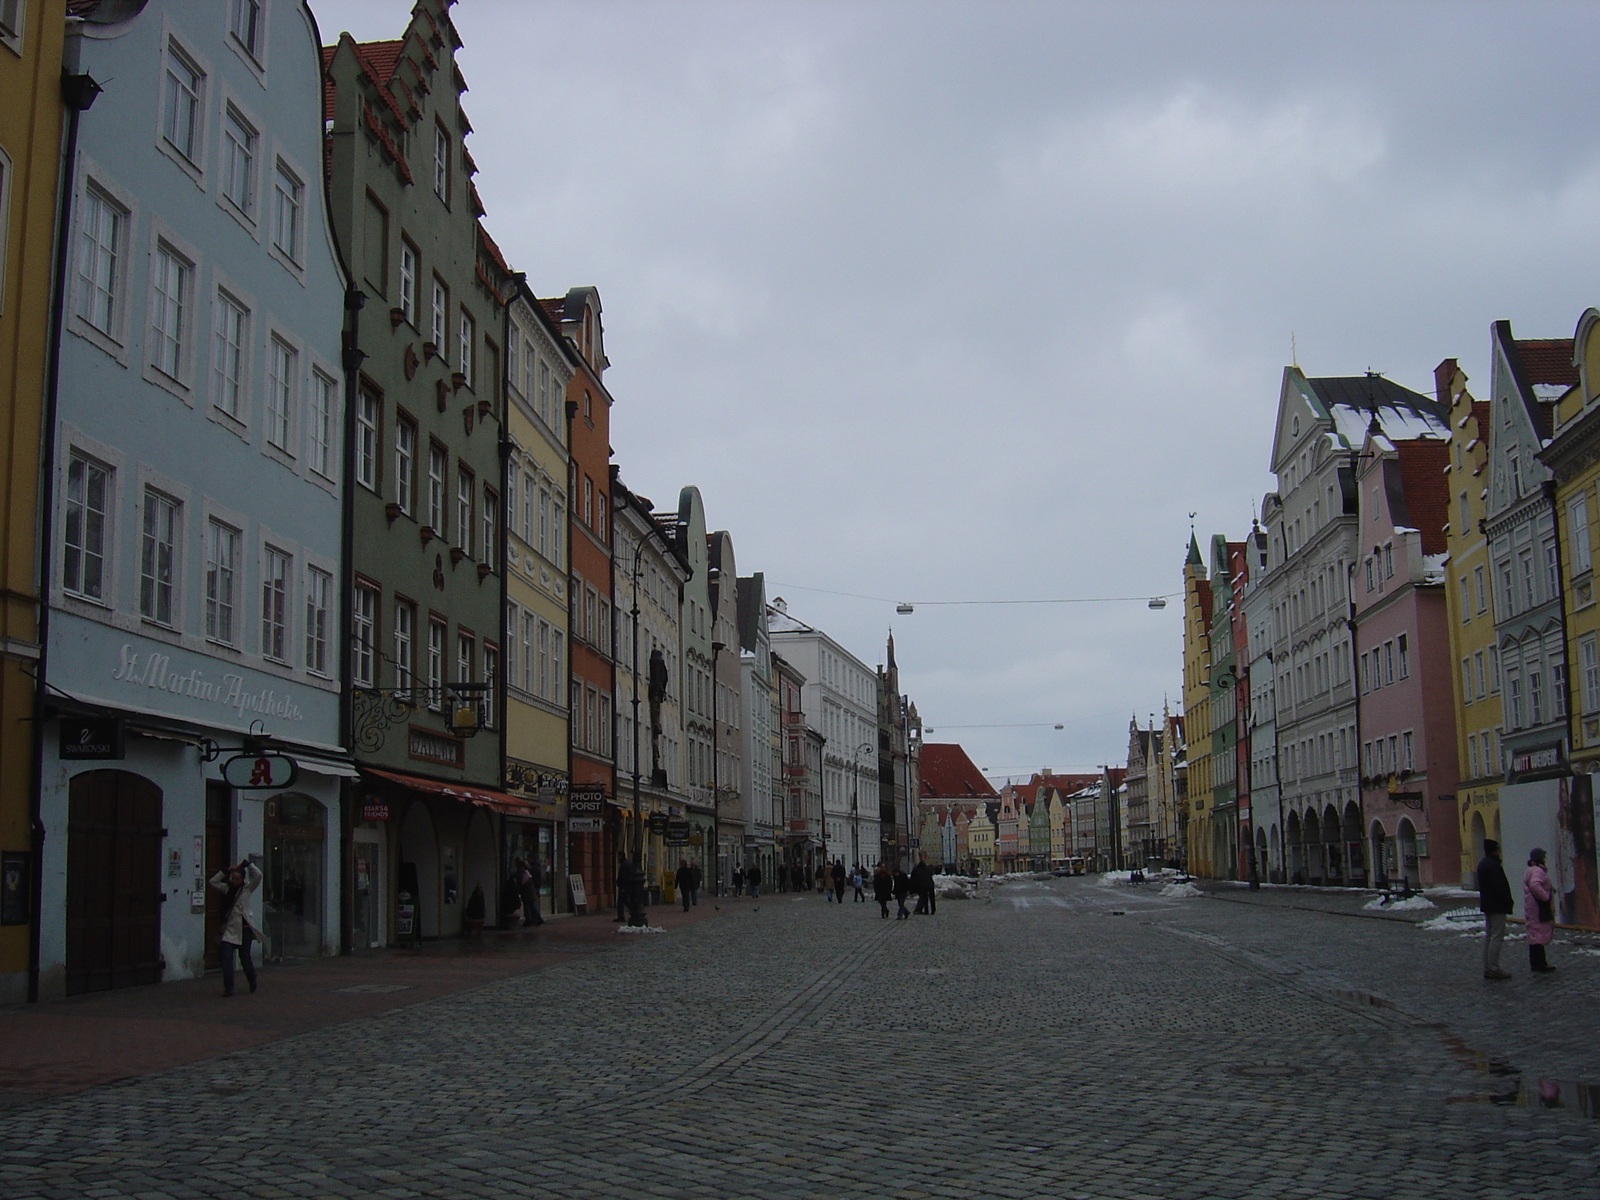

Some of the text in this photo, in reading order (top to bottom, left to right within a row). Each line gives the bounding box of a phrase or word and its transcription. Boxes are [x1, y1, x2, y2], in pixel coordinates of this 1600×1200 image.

[138, 652, 223, 702] Martins
[66, 744, 110, 753] SWAROVSKI
[249, 757, 273, 786] A
[570, 792, 602, 801] PHOTO
[570, 802, 601, 811] PORST
[592, 819, 600, 827] M
